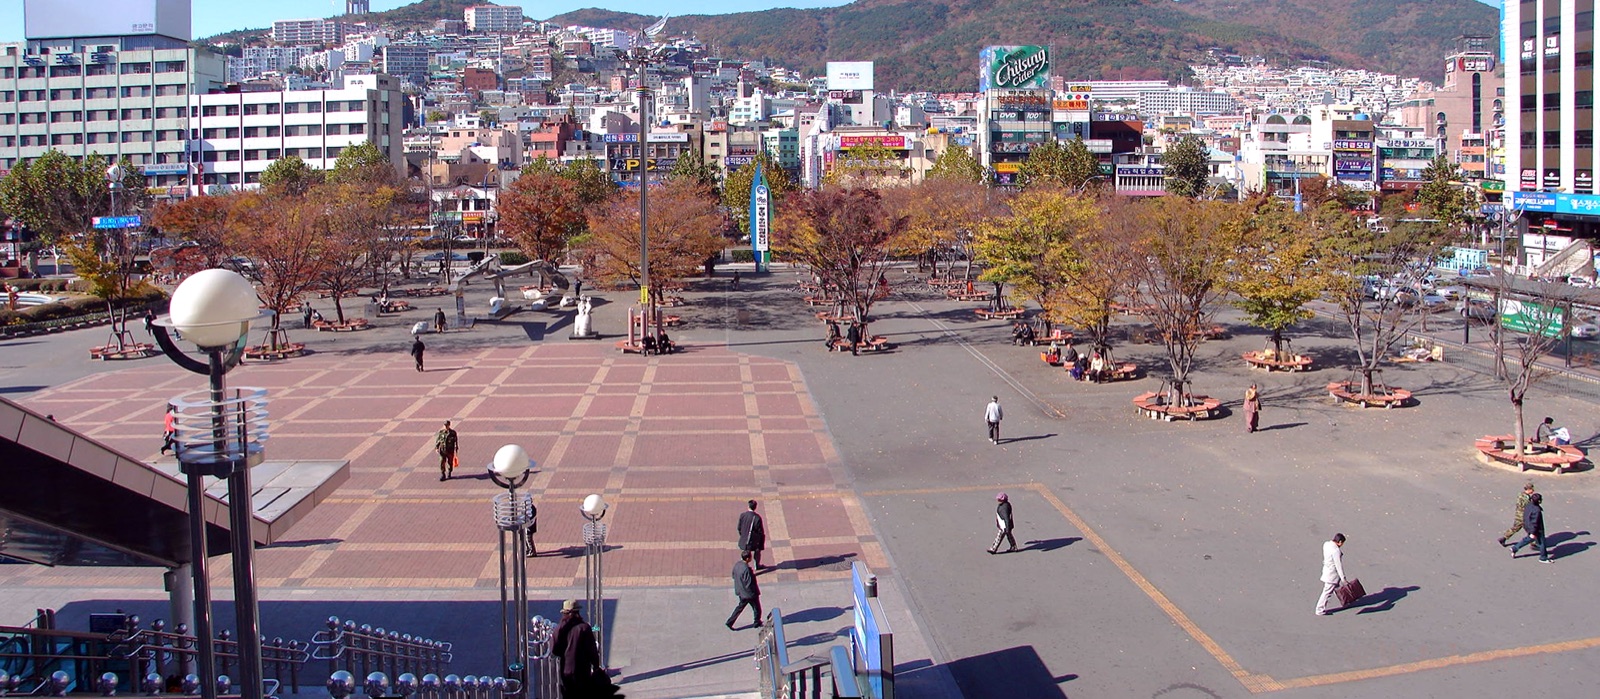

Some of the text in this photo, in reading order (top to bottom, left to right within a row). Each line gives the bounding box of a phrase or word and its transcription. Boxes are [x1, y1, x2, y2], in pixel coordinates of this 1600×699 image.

[996, 48, 1047, 87] Chilsung
[730, 157, 752, 165] 직업소개
[1571, 199, 1600, 210] 웰스정수
